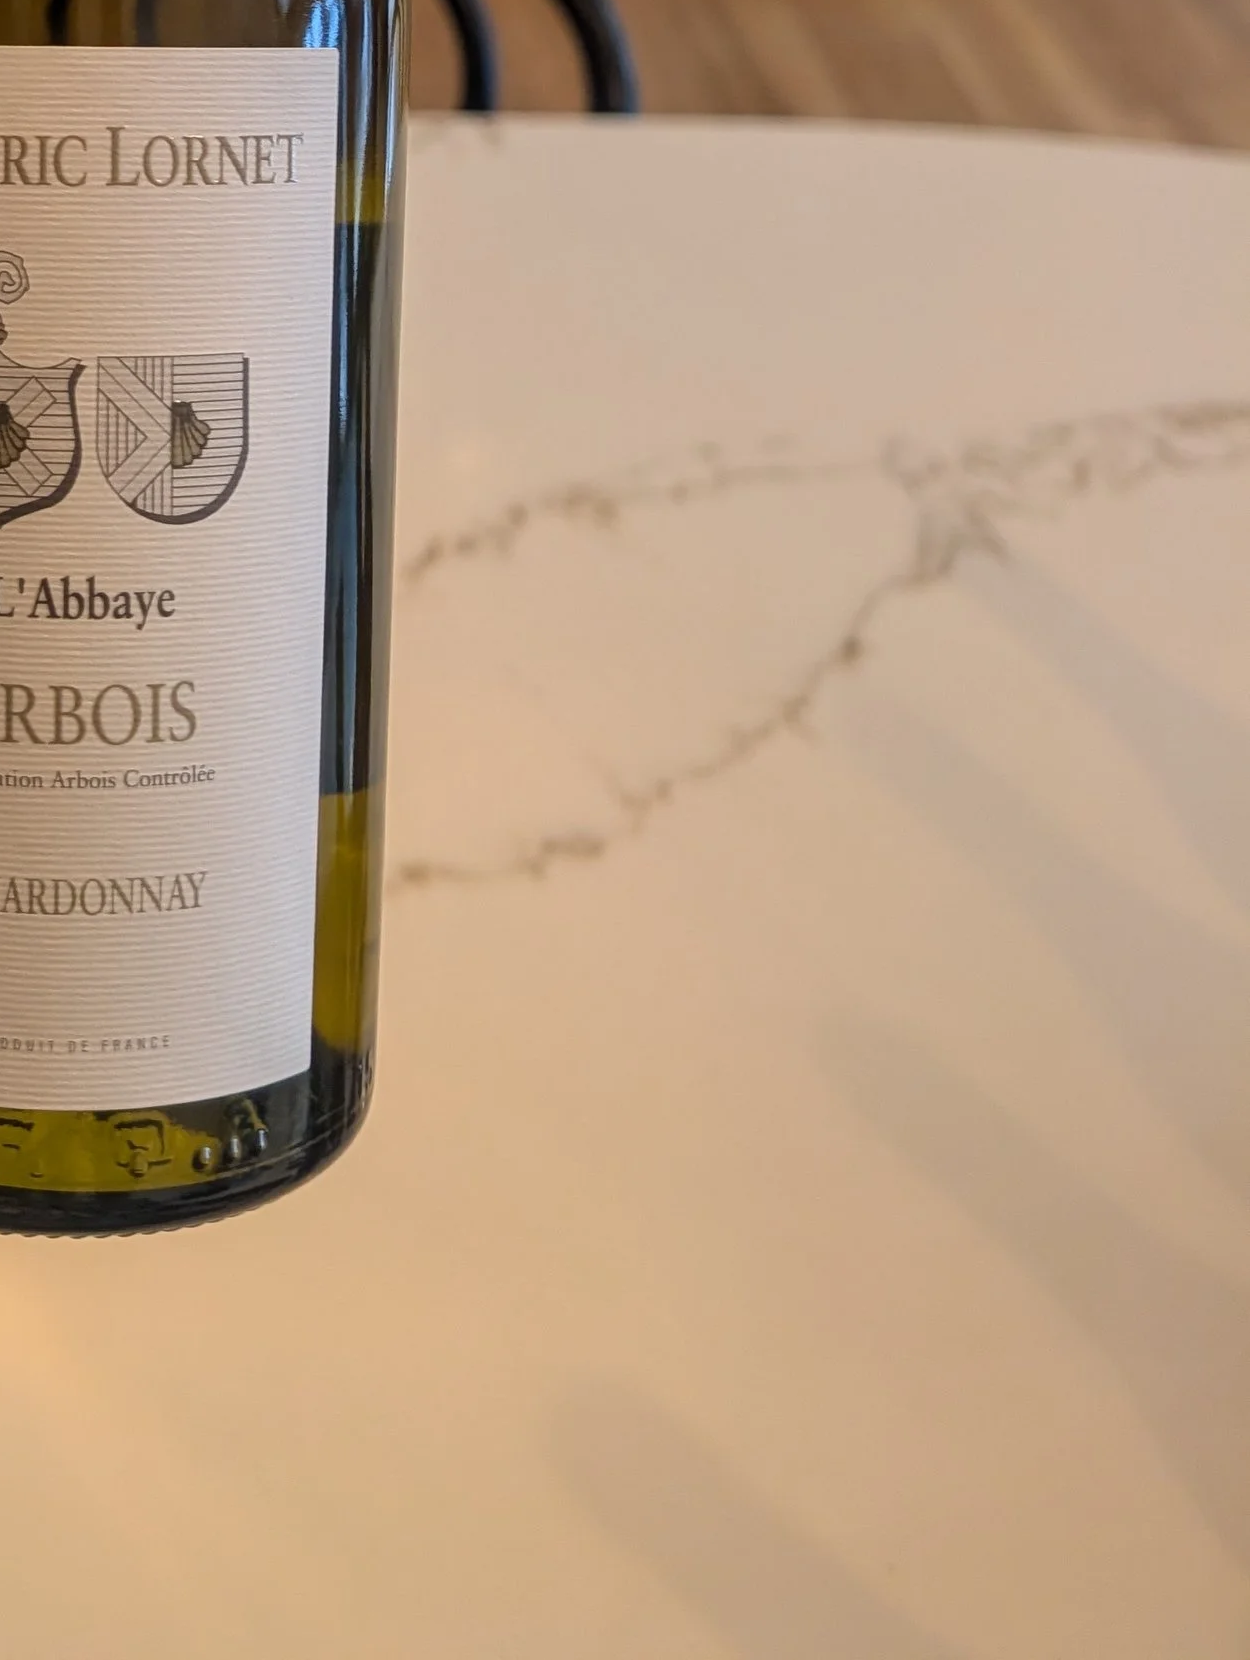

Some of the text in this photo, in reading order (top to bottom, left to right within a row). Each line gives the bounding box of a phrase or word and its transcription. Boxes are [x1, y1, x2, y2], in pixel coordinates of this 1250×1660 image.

[106, 125, 304, 187] LORNET
[50, 770, 116, 789] Arbois
[123, 764, 216, 788] Contrôlée
[68, 1040, 89, 1053] DE
[101, 1035, 170, 1051] FRANCE
